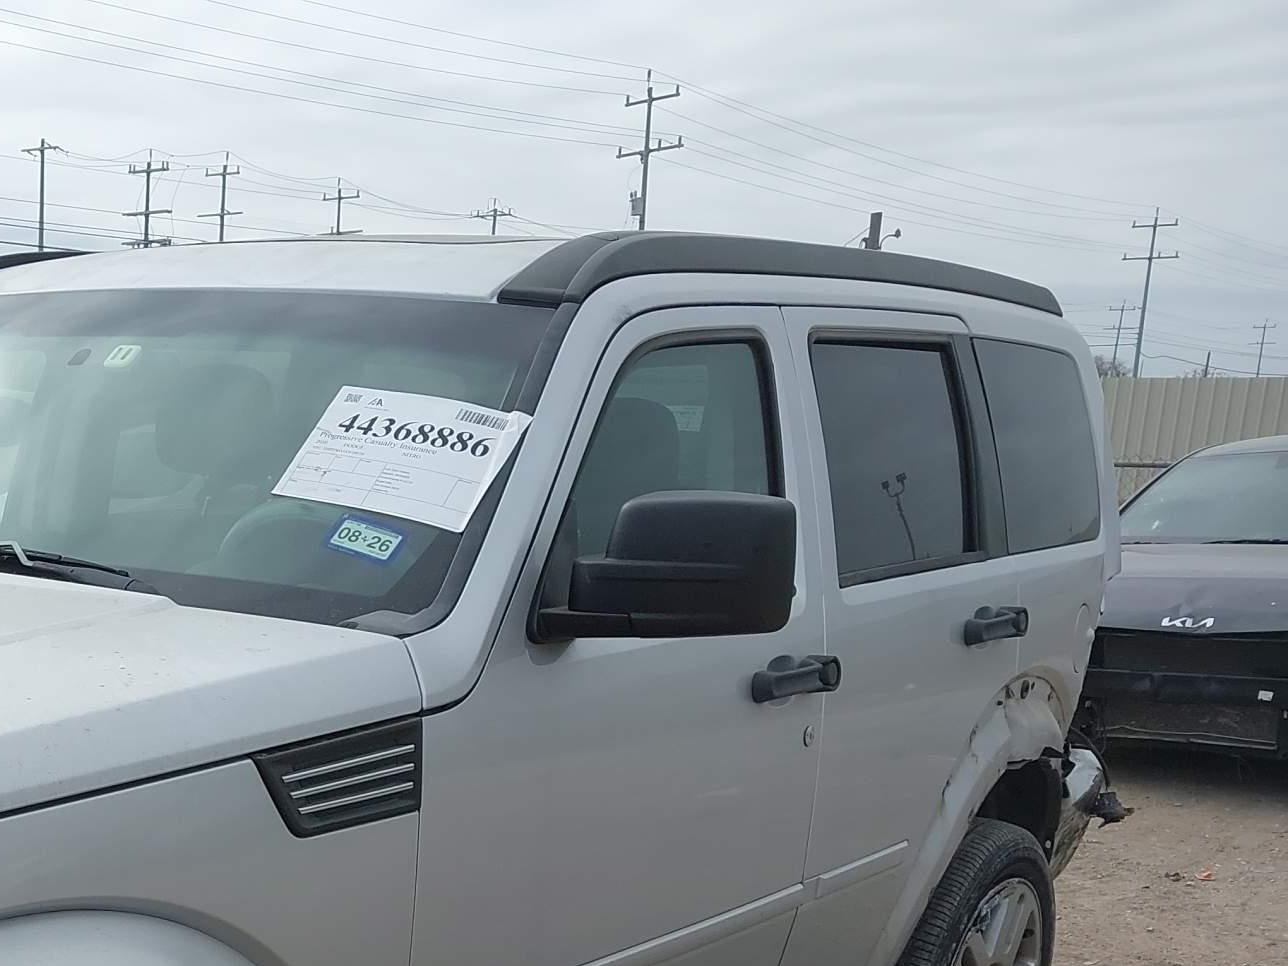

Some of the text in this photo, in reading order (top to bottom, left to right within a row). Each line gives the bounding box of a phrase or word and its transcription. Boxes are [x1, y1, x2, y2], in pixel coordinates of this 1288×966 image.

[319, 431, 438, 455] Progressive Casualty Insurance
[338, 413, 497, 457] 44368886
[1161, 616, 1215, 628] KIA
